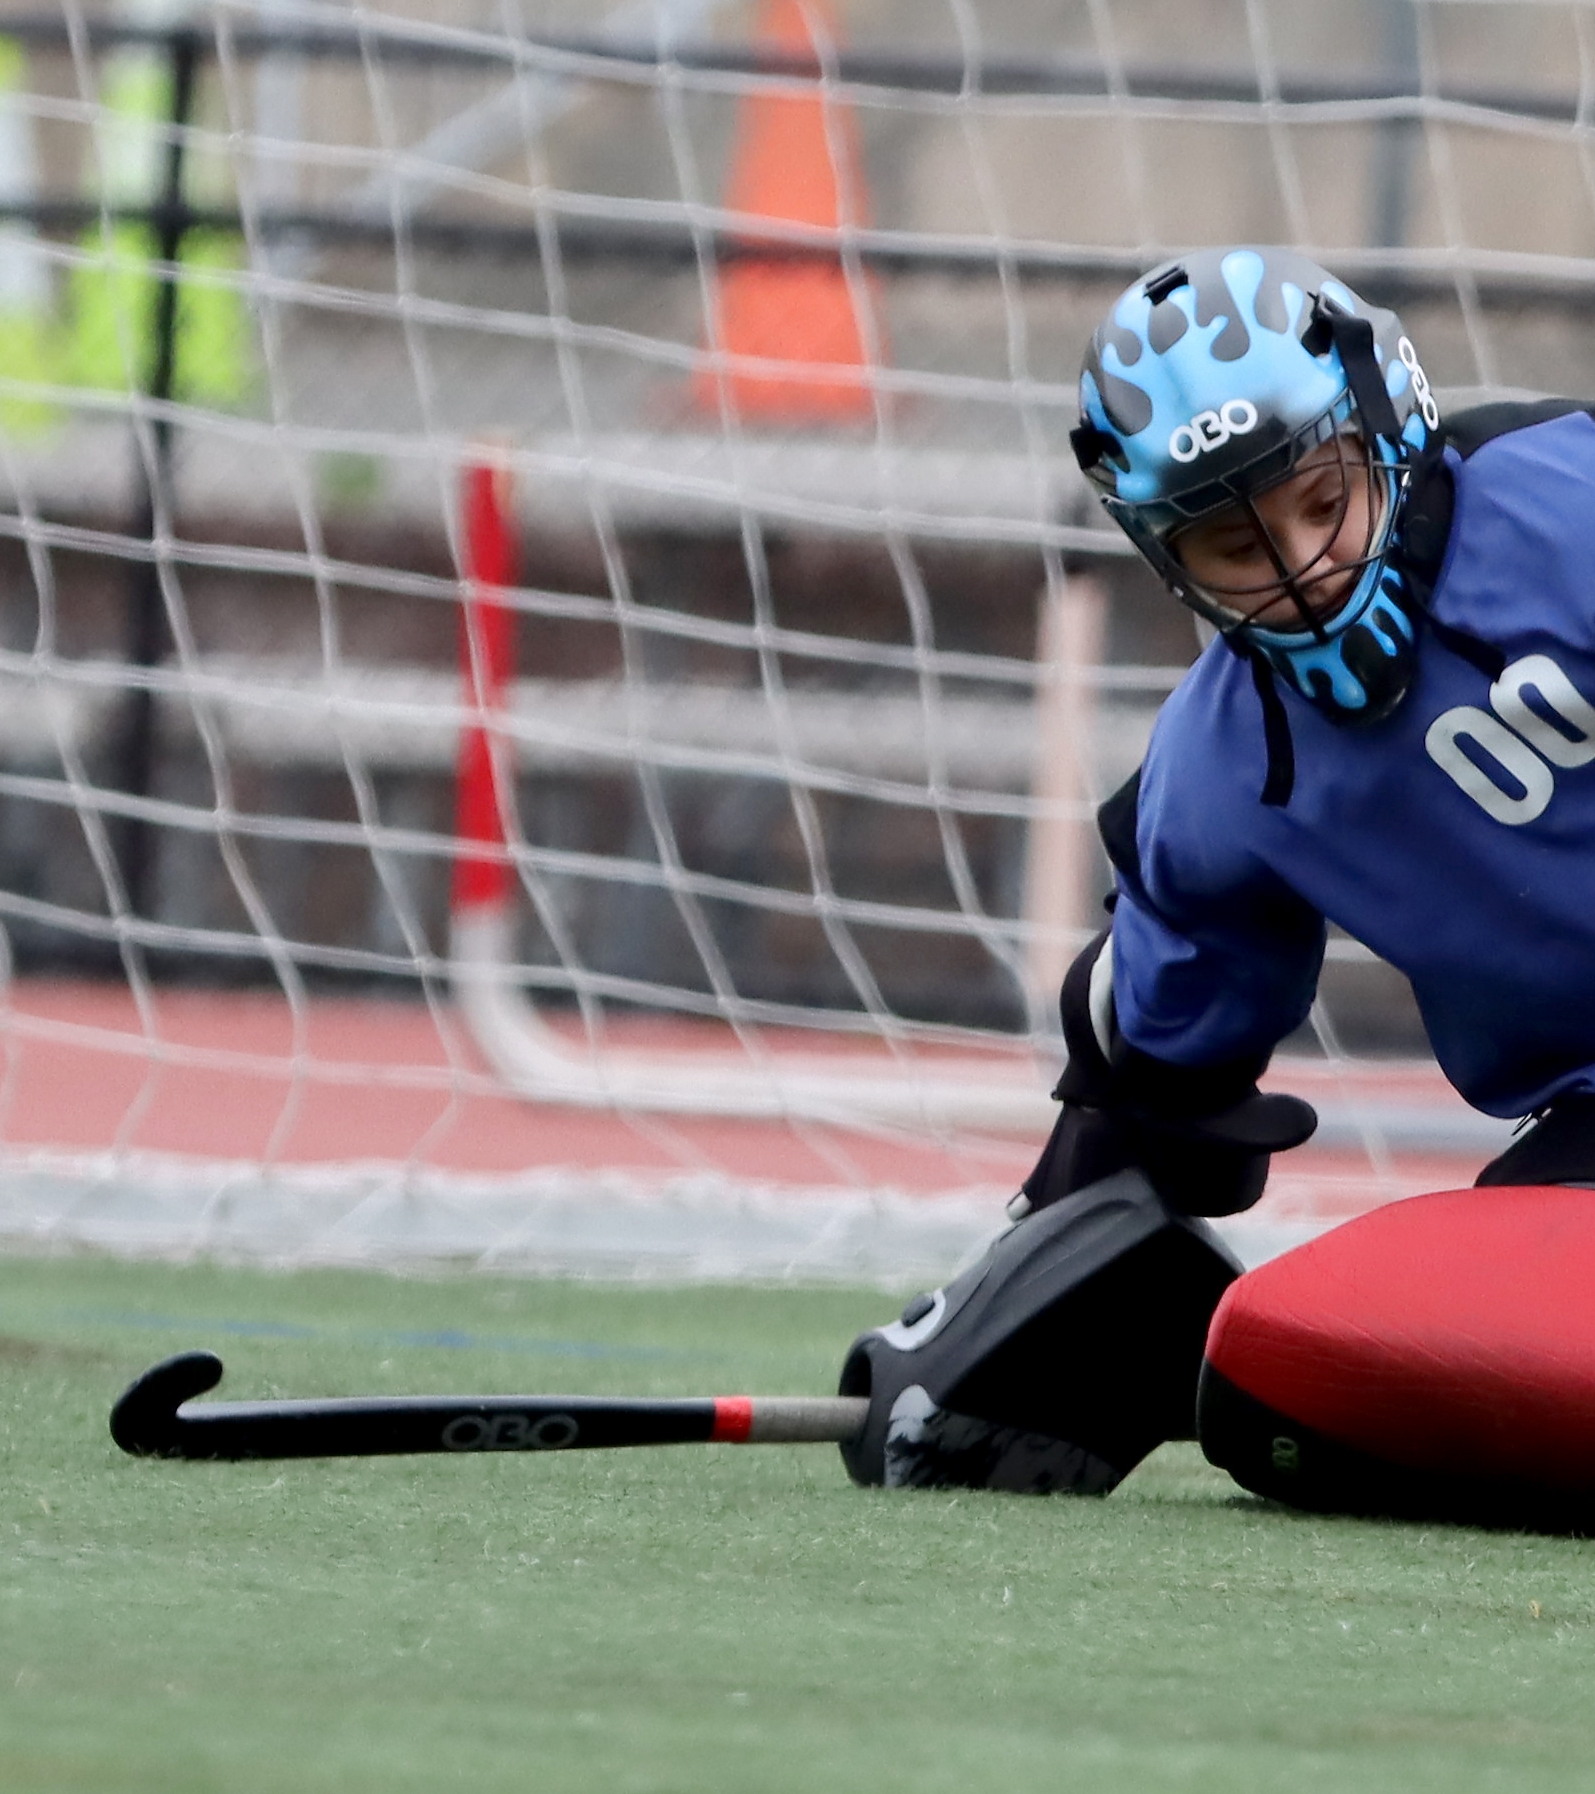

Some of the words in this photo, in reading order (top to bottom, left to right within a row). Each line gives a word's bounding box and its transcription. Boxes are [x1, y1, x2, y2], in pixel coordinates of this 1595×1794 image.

[1398, 336, 1439, 431] OBO
[1169, 399, 1258, 463] OBO
[442, 1414, 579, 1450] OBO
